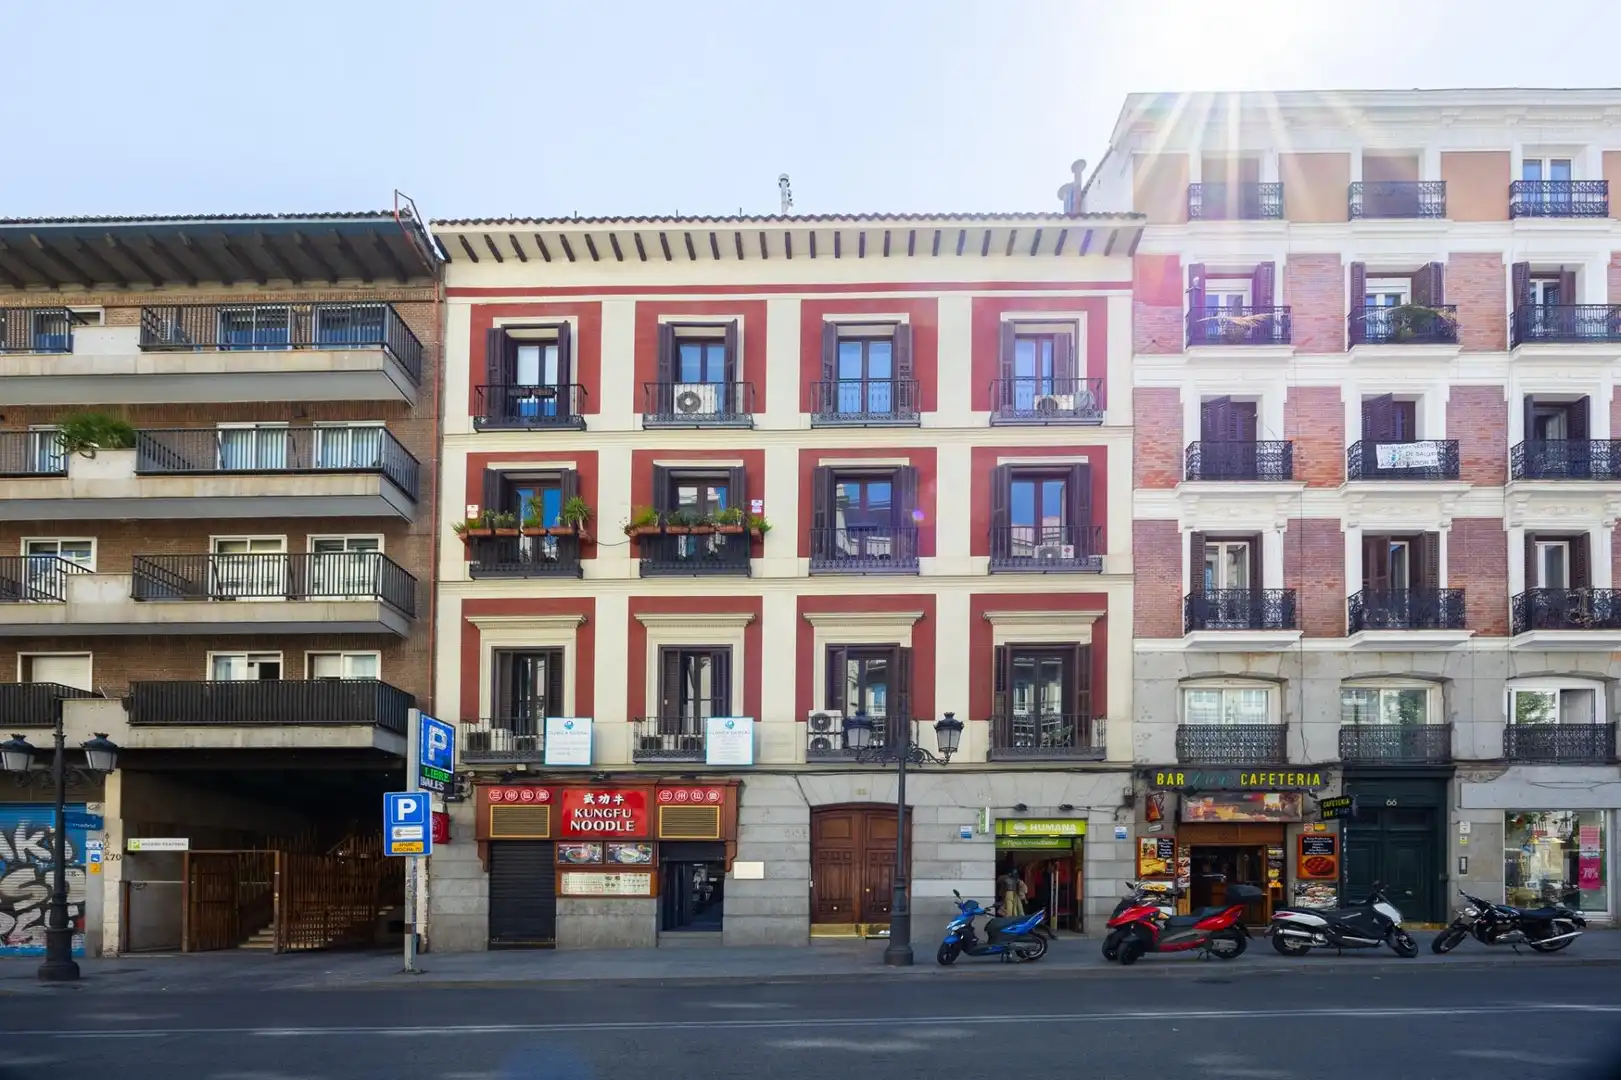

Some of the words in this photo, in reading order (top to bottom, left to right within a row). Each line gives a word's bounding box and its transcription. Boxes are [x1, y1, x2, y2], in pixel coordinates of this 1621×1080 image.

[428, 724, 448, 761] P
[424, 767, 450, 783] LIBRE
[1156, 772, 1185, 786] BAR
[1240, 772, 1321, 786] CAFETERIA
[583, 792, 625, 806] 武功牛
[397, 798, 417, 821] P
[574, 808, 632, 819] KUNGFU
[570, 820, 635, 832] NOODLE
[1030, 823, 1077, 832] HUMANA
[110, 853, 122, 861] 70
